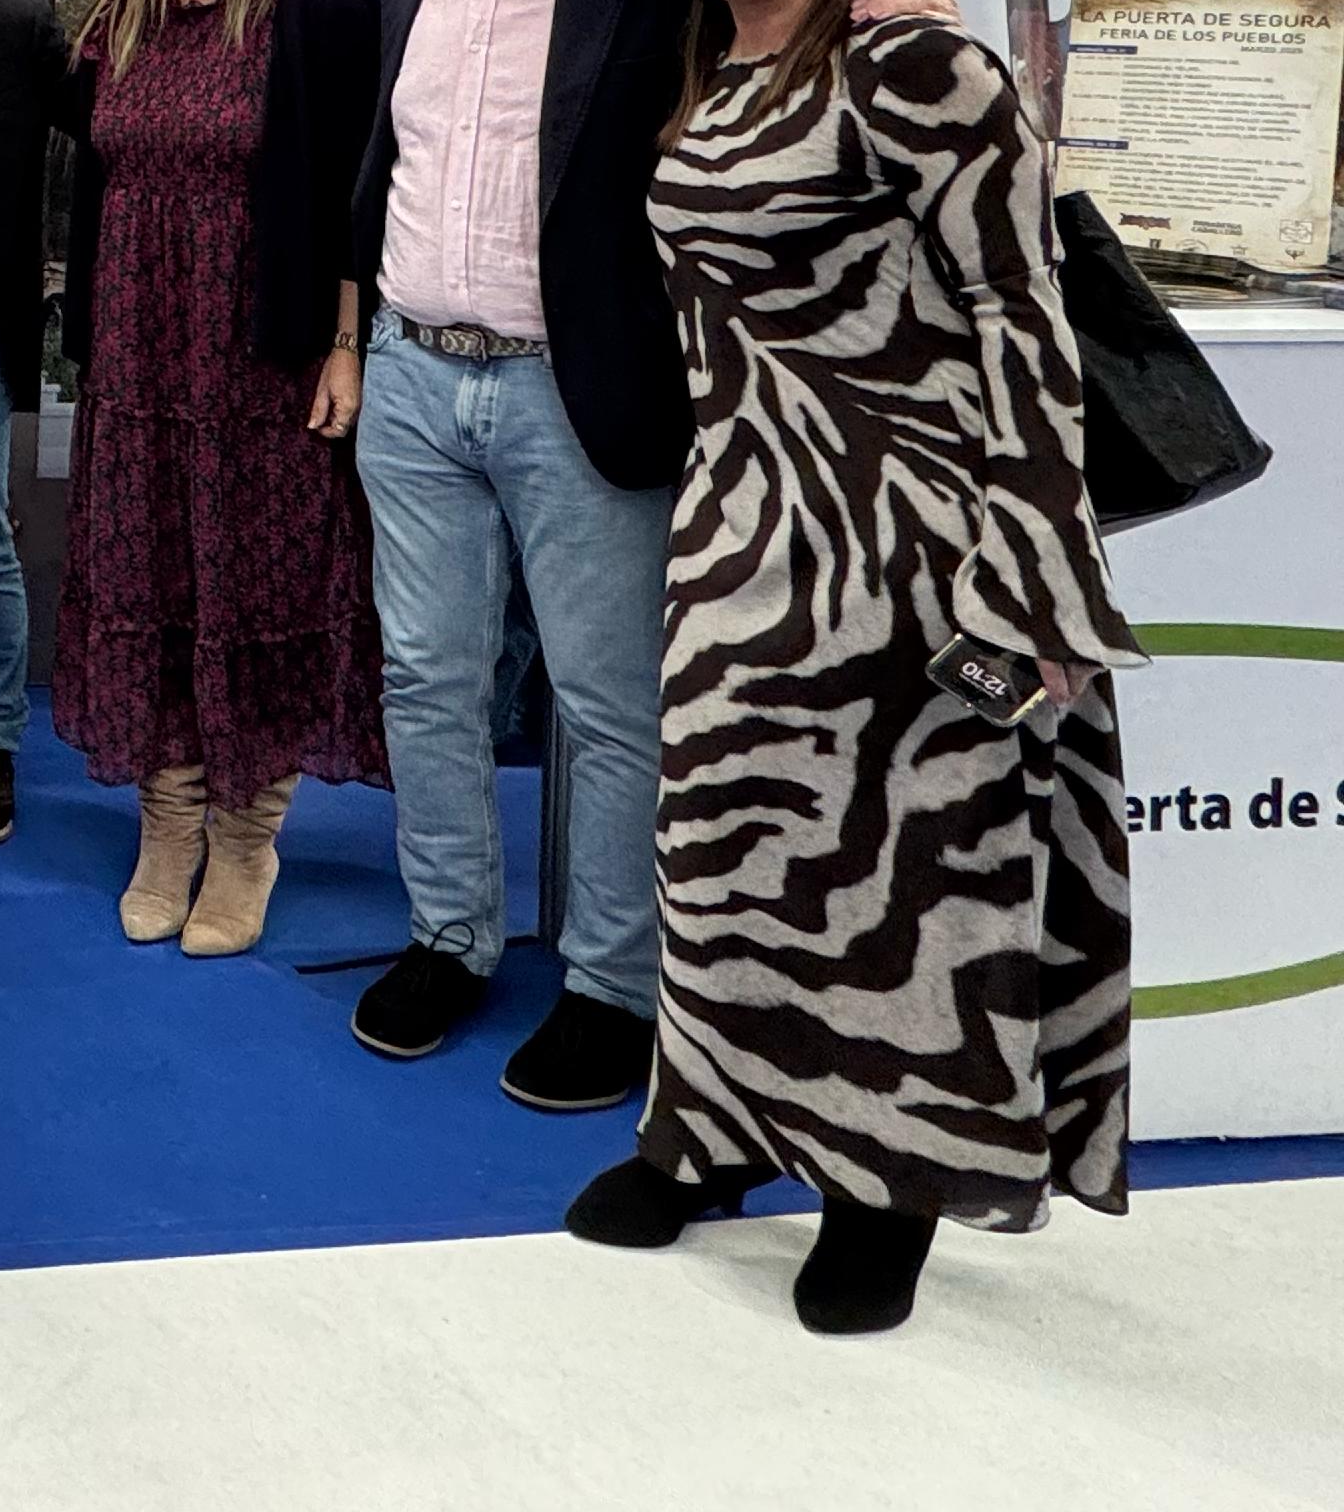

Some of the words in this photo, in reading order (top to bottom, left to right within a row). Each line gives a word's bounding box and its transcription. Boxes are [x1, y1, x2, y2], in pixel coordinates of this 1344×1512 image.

[1080, 10, 1106, 24] LA
[1113, 10, 1196, 26] PUERTA
[1203, 12, 1232, 27] DE
[1238, 13, 1331, 29] SEGURA
[1100, 28, 1148, 40] FERIA
[1154, 29, 1178, 41] DE
[1182, 30, 1216, 42] LOS
[1222, 31, 1306, 45] PUEBLOS
[1248, 776, 1320, 829] de
